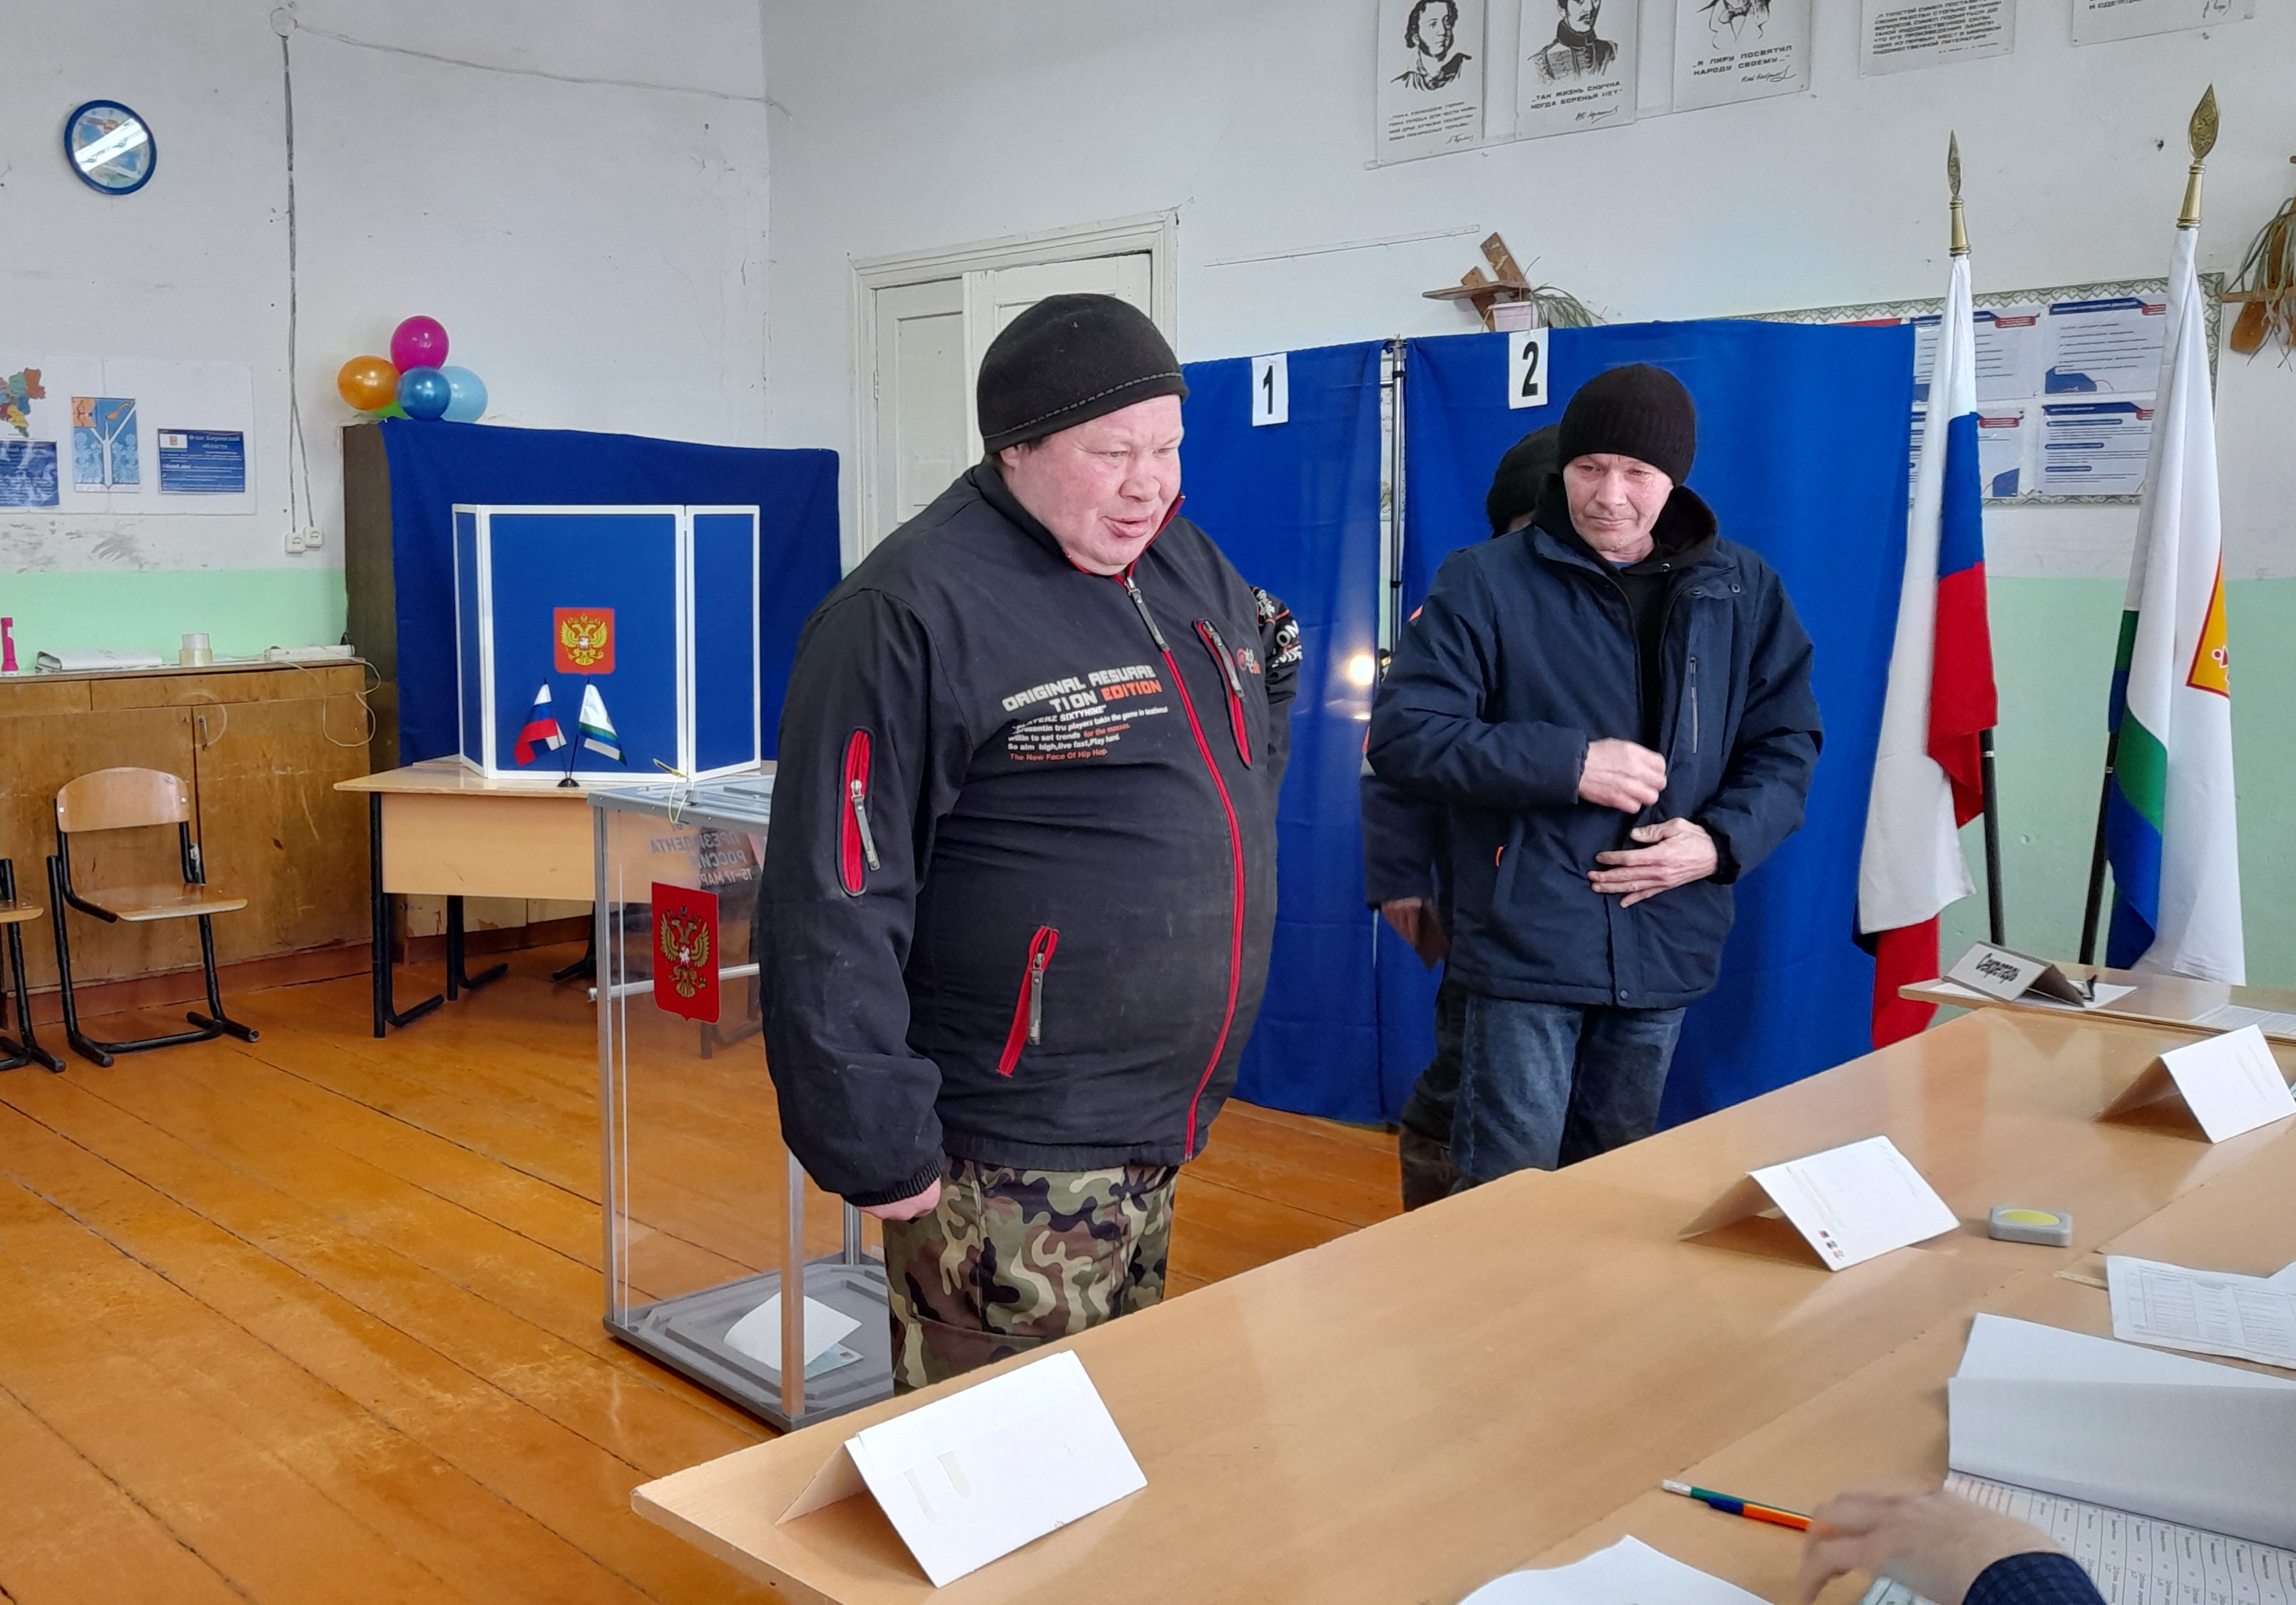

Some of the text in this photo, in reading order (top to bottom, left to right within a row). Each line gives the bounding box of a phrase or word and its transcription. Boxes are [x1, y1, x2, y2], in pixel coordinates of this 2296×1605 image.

[1710, 56, 1735, 64] ЛИРУ
[1740, 45, 1792, 59] ПОСВЯТИЛ
[1693, 65, 1732, 76] НАРОДУ
[1556, 88, 1583, 97] ЖИЗНЬ
[1561, 93, 1598, 104] БОРЕНЬЯ
[1521, 341, 1539, 397] 2
[1262, 365, 1274, 414] 1
[1101, 680, 1163, 701] EDITION
[1068, 718, 1093, 731] playerz
[1094, 714, 1111, 724] takin
[1111, 712, 1121, 720] the
[1123, 711, 1138, 720] game
[1078, 750, 1091, 759] Hip
